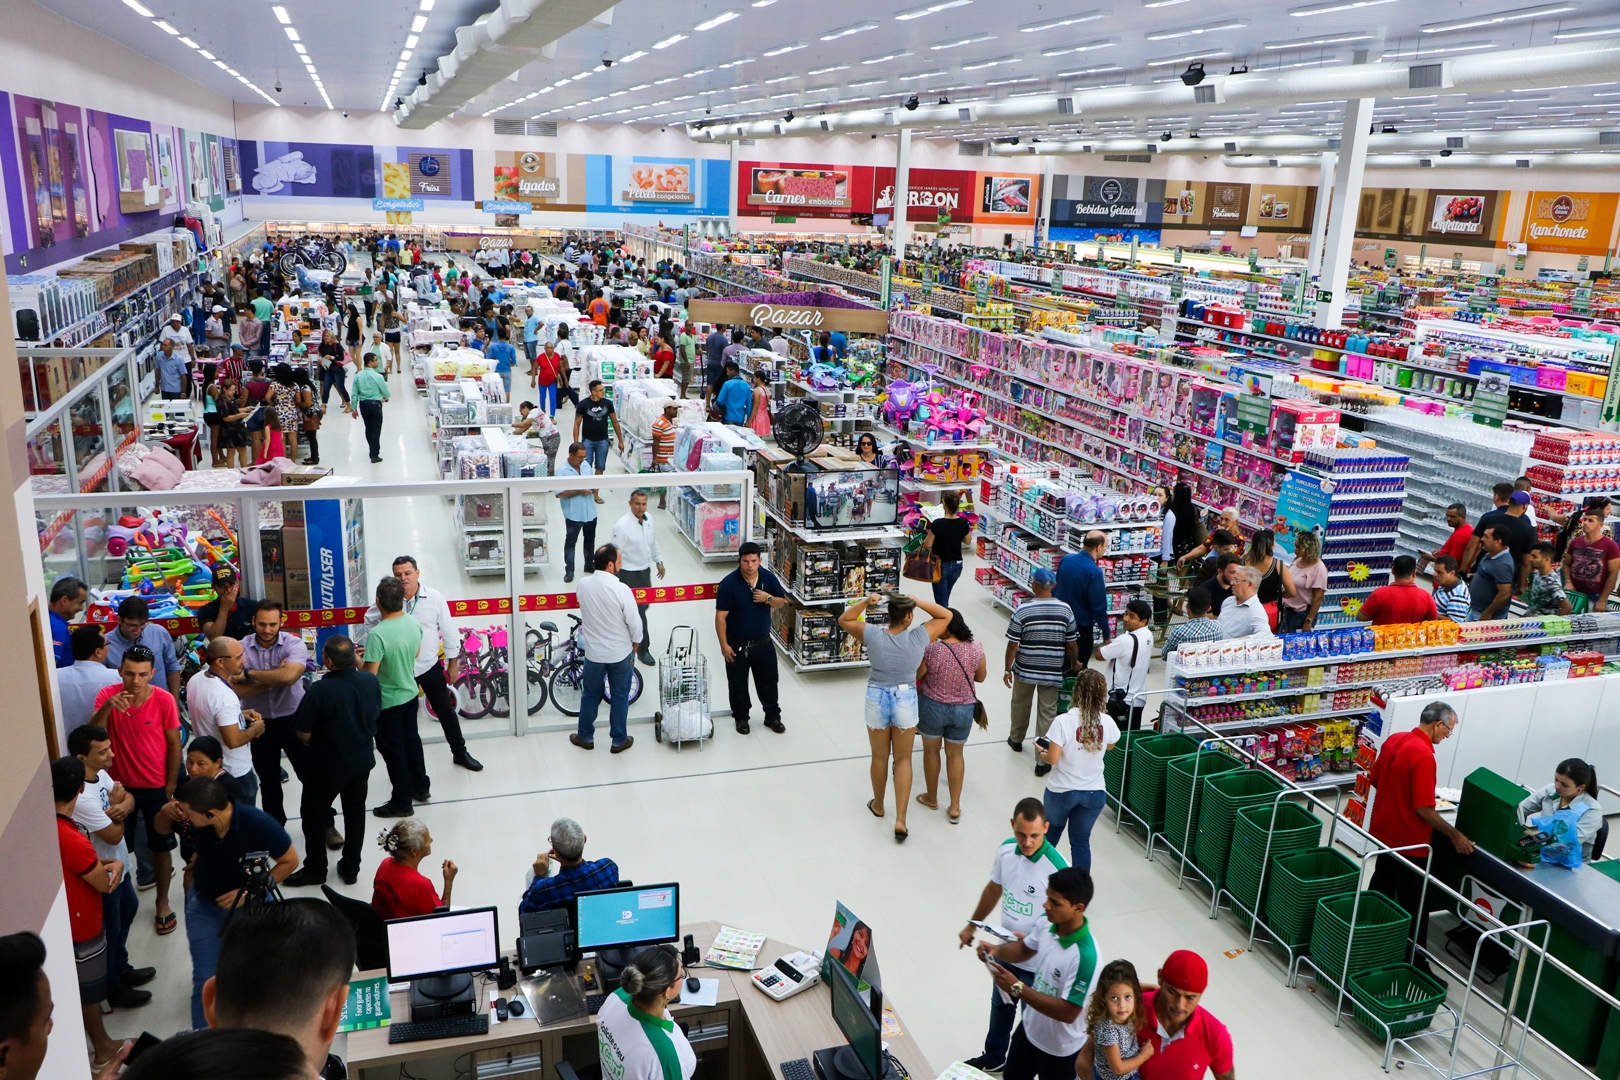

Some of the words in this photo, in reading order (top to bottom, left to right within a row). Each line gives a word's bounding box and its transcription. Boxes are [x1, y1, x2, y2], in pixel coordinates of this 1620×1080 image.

[419, 182, 439, 192] Frios
[519, 180, 555, 194] lgados
[628, 188, 656, 198] Peixes
[765, 190, 805, 204] Carnes
[907, 191, 958, 208] RIGON
[377, 200, 420, 209] Congelados
[486, 203, 528, 211] Congelados
[1076, 203, 1109, 214] Bebidas
[1110, 204, 1142, 217] Geladas
[1432, 222, 1478, 234] Confeitaria
[1530, 222, 1589, 240] Lanchonete
[479, 237, 513, 249] Bazar
[750, 303, 824, 327] Bazar
[1609, 381, 1618, 405] Consulta
[320, 547, 334, 610] ULTILASER
[355, 988, 364, 1003] guardar
